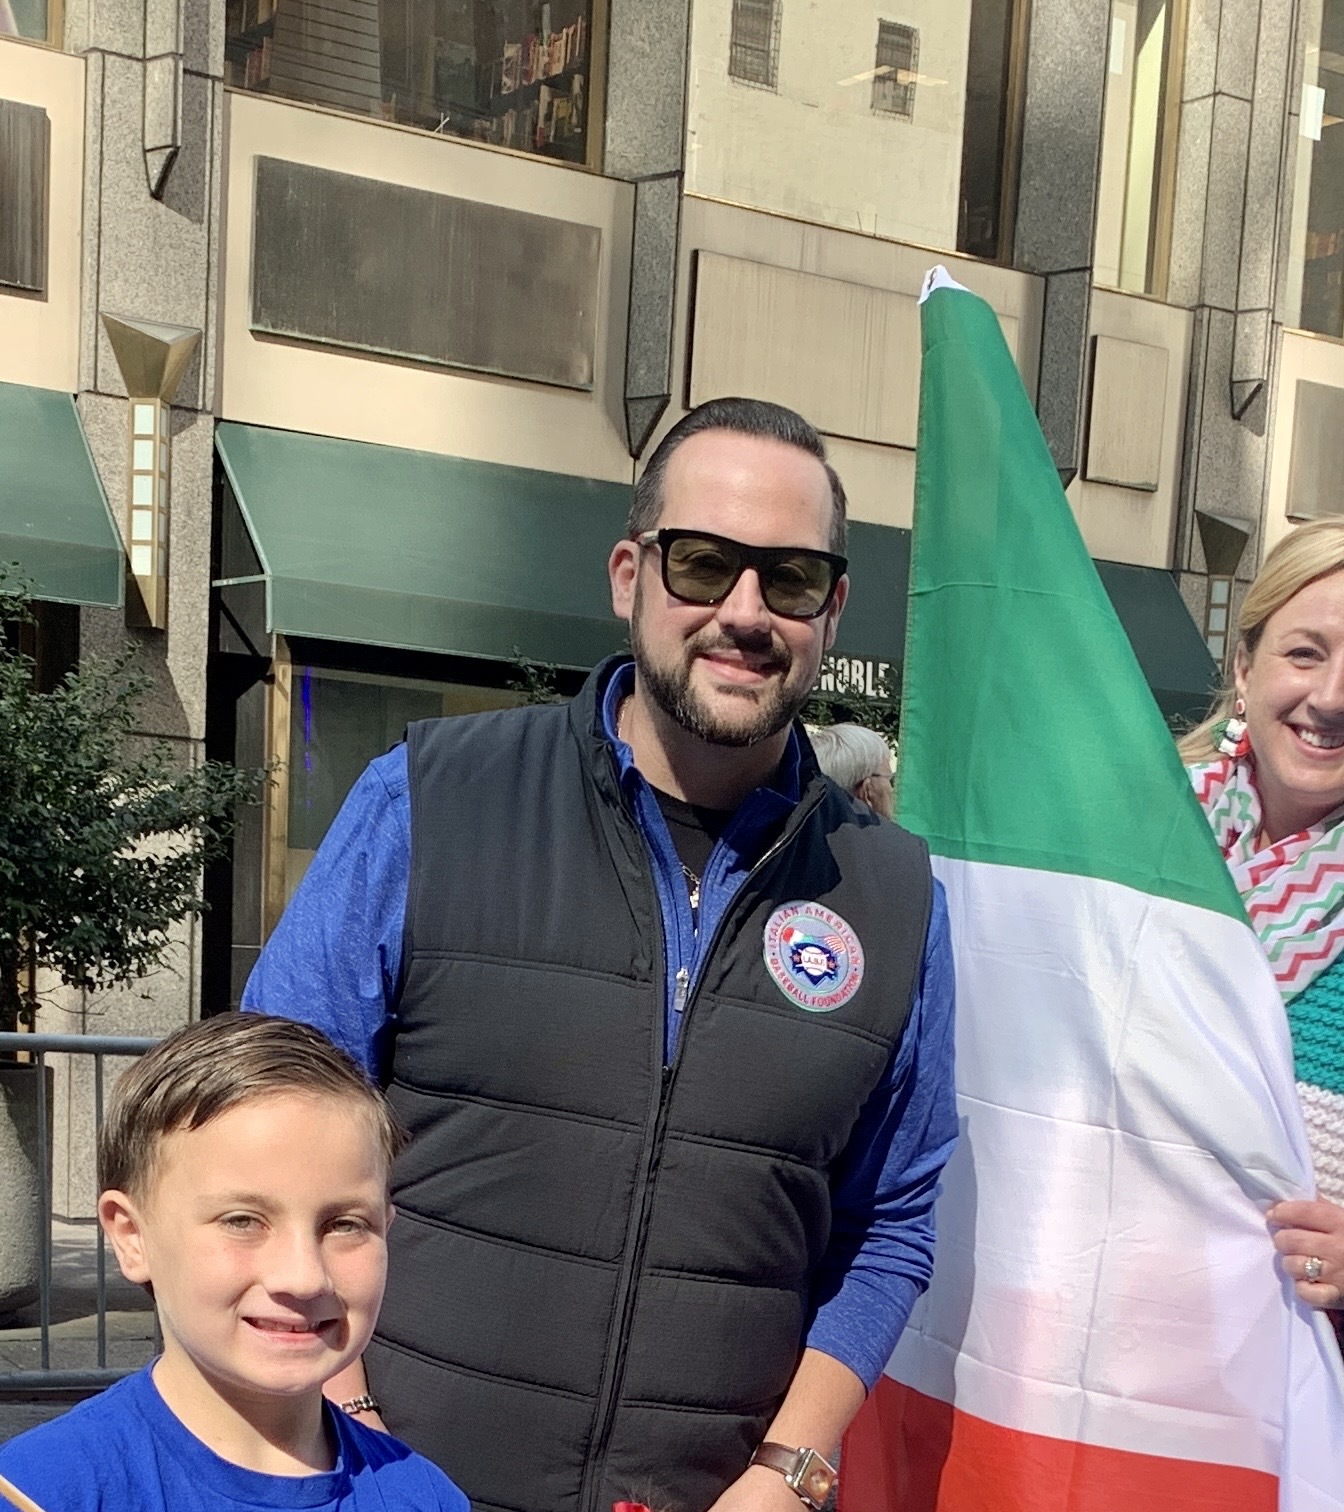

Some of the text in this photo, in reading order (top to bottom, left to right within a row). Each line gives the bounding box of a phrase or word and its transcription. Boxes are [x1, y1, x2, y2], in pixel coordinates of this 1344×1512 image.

[812, 656, 891, 698] NOBLE
[768, 906, 861, 965] ITALIAN AMERICAN
[770, 958, 860, 1008] BASEBALL FOUNDATION
